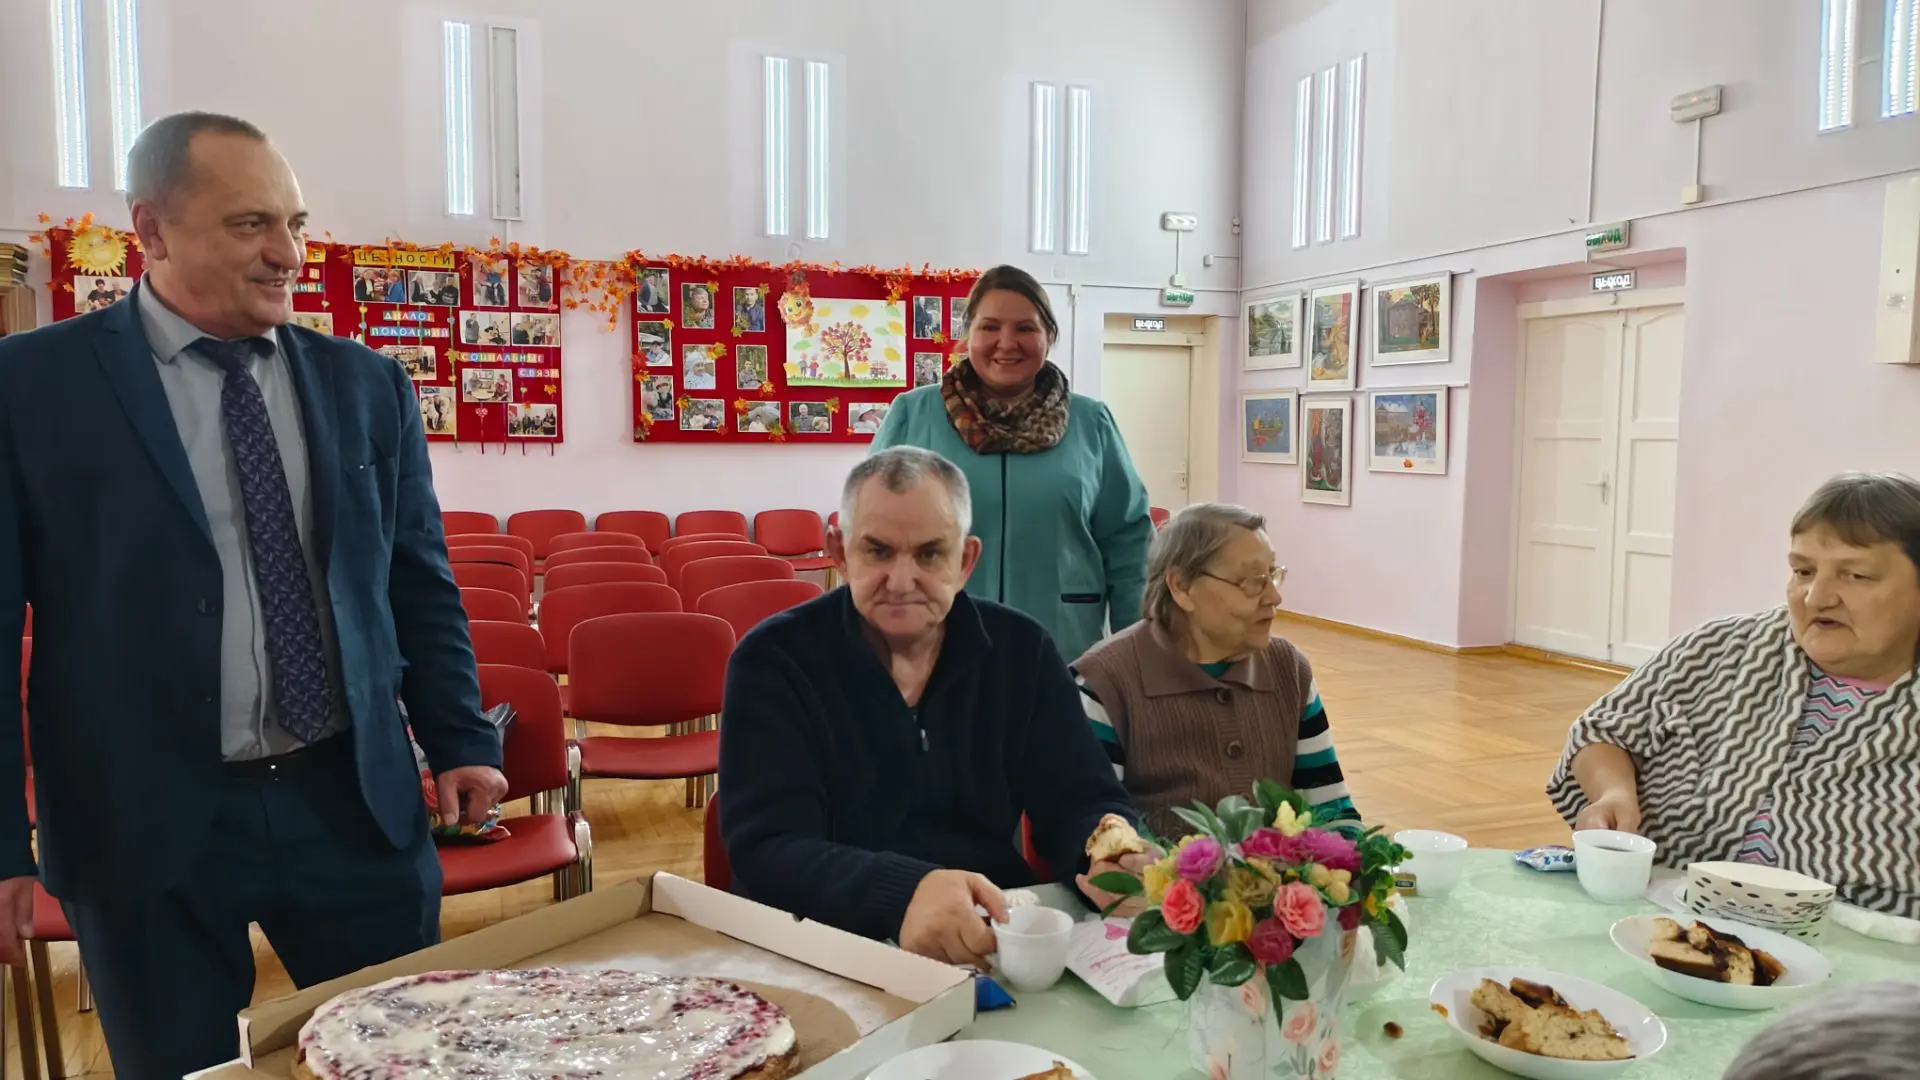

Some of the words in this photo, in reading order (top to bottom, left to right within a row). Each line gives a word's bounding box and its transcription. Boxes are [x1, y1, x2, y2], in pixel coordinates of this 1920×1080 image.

[1595, 274, 1631, 289] ВЫХОД
[383, 311, 434, 322] ДИАЛОГ
[461, 352, 544, 363] СОЦИАЛЬНЫЕ
[518, 368, 559, 378] СВЯЗИ
